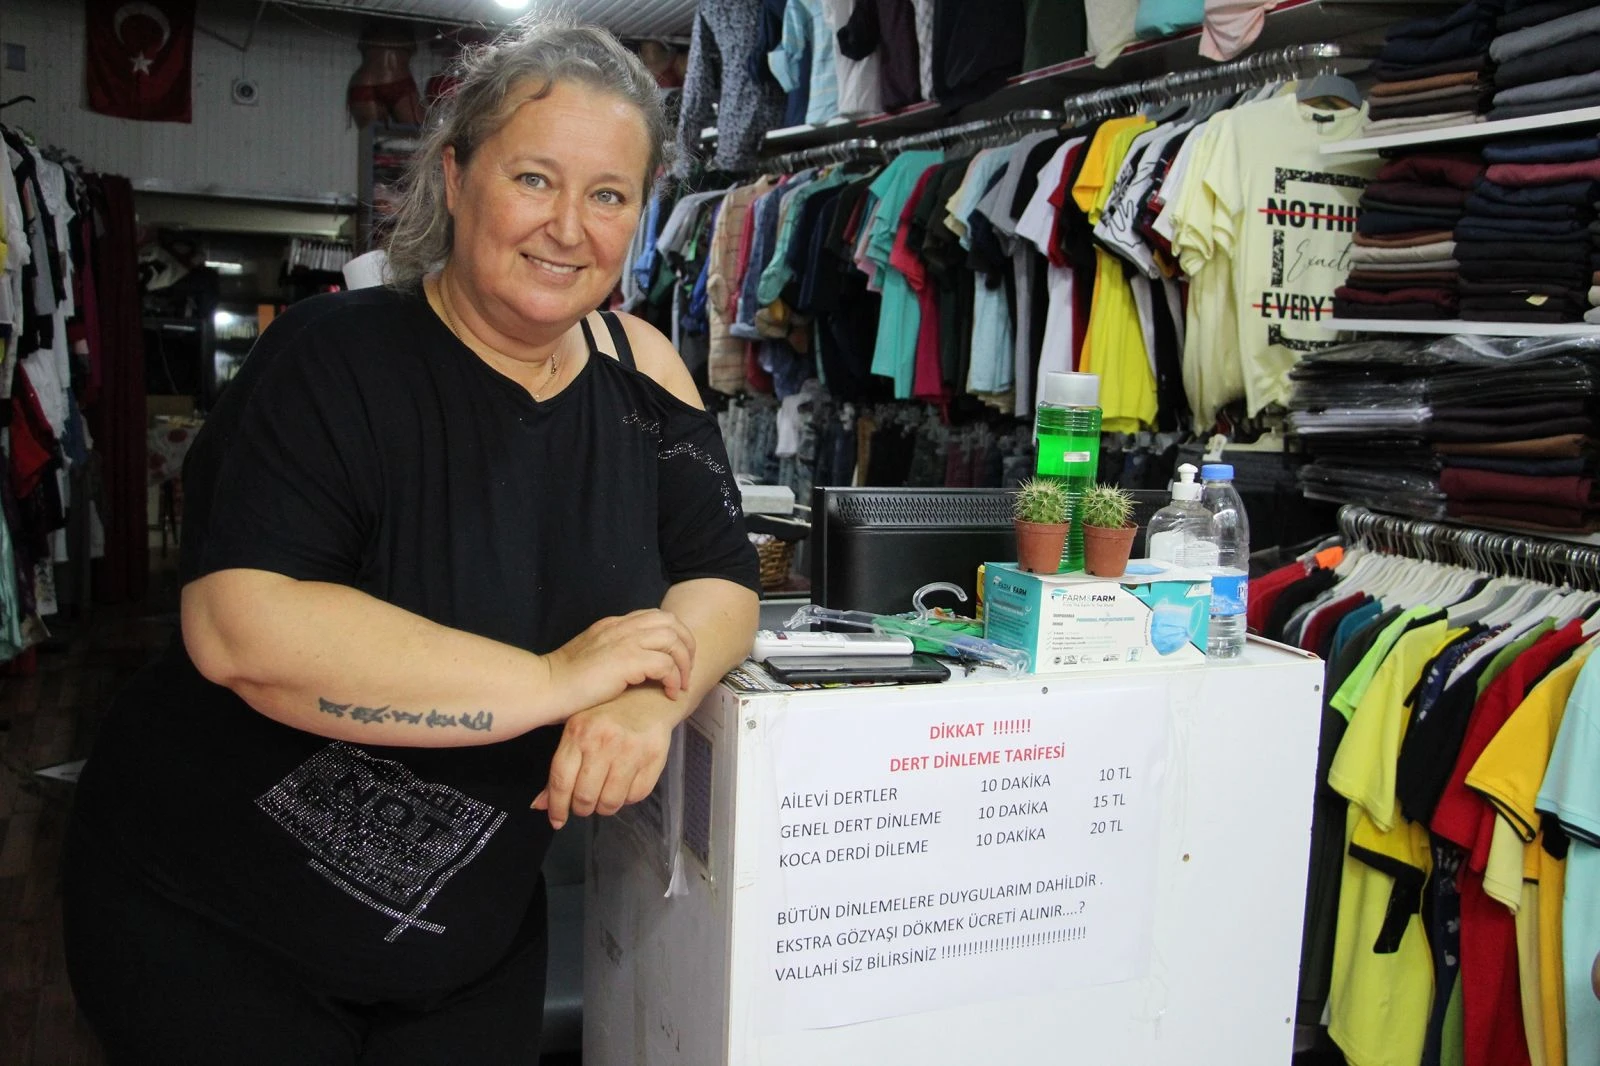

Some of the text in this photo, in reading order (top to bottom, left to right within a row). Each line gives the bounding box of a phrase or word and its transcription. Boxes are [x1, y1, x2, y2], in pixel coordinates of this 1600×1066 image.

[929, 721, 985, 740] DİKKAT
[890, 741, 1066, 773] DERT DİNLEME TARİFESİ
[780, 766, 1132, 810] AİLEVİ DERTLER 10 DAKİKA 10 TL
[780, 793, 1126, 839] GENEL DERT DİNLEME 10 DAKİKA 15 TL
[779, 819, 1124, 869] KOCA DERDİ DİLEME 10 DAKİKA 20 TL
[777, 904, 831, 926] BÜTÜN
[835, 894, 935, 919] DİNLEMELERE
[939, 884, 1032, 906] DUYGULARIM
[1036, 873, 1096, 894] DAHİLDİR
[776, 934, 833, 954] EKSTRA
[836, 924, 898, 947] GÖZYAŞI
[902, 916, 965, 938] DÖKMEK
[968, 908, 1016, 929] ÜCRETİ
[774, 958, 838, 982] VALLAHİ
[841, 953, 865, 974] SİZ
[867, 945, 937, 970] BİLİRSİNİZ
